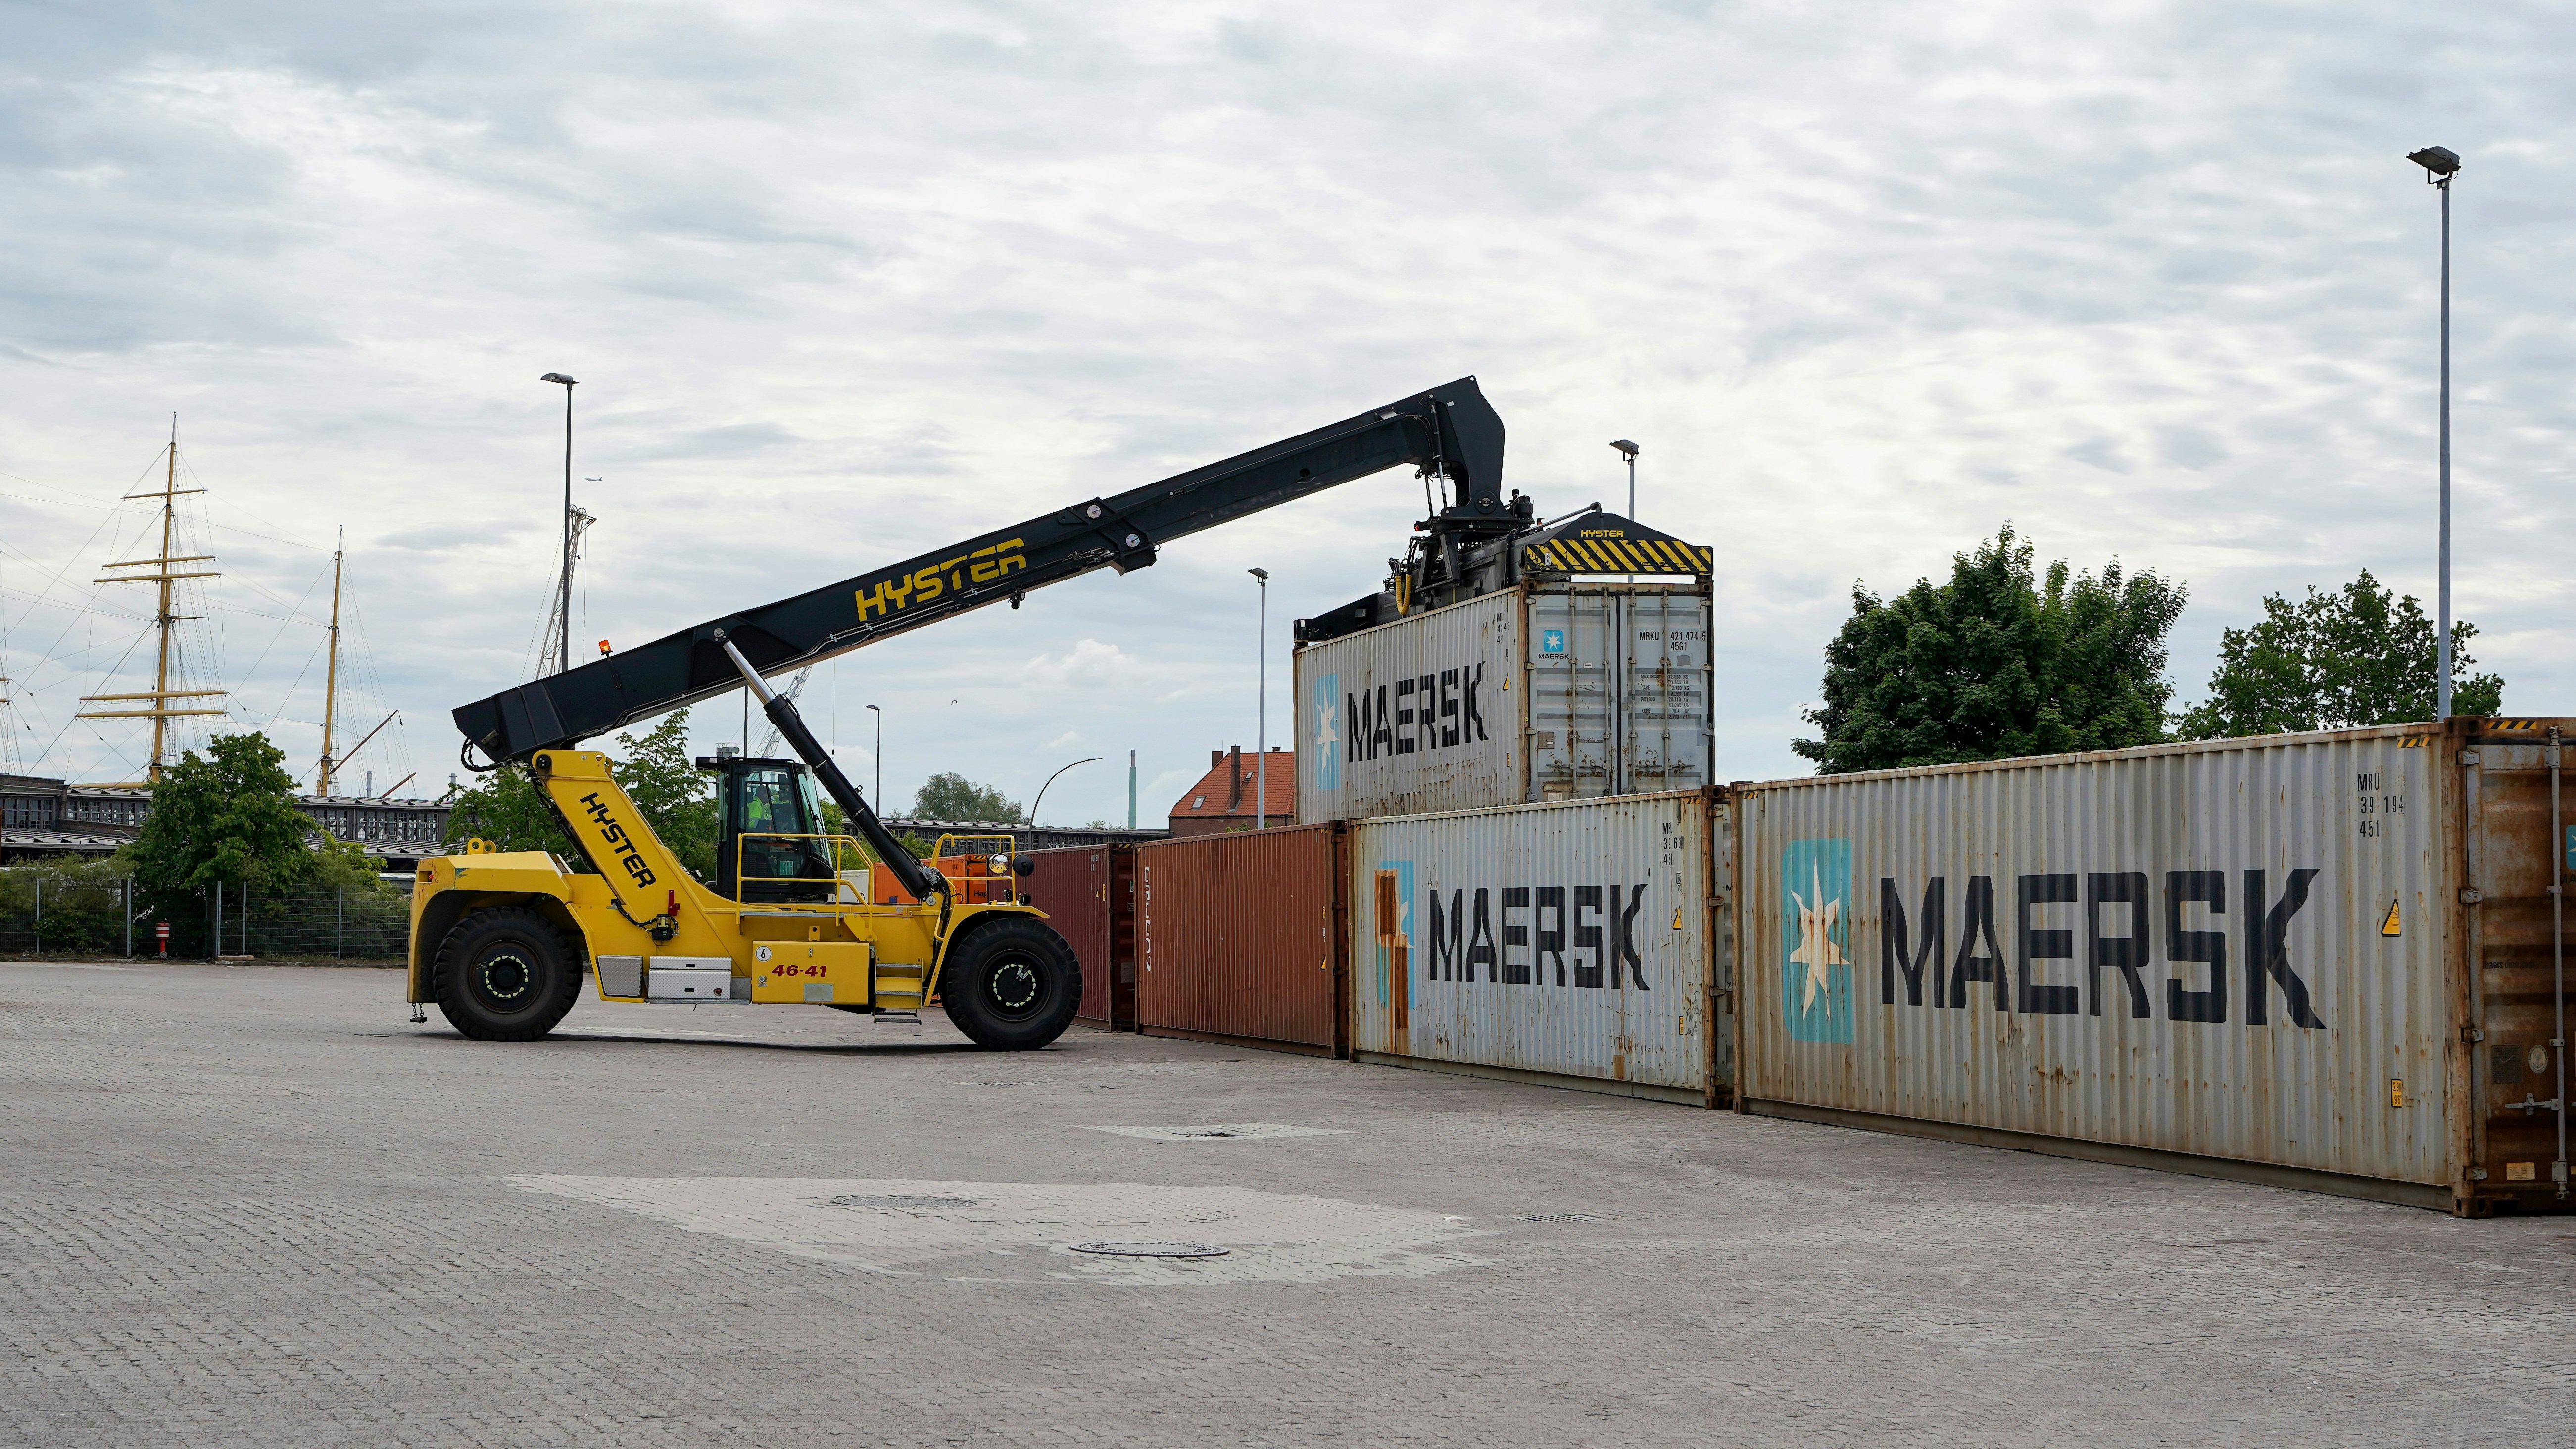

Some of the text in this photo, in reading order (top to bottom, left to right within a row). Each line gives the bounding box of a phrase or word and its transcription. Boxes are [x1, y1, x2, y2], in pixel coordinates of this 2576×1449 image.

[1581, 530, 1624, 538] HYSTER
[855, 538, 1027, 622] HYSTER
[1639, 631, 1659, 641] MRKU
[1670, 632, 1682, 641] 421
[1685, 632, 1698, 641] 474
[1670, 642, 1687, 651] 45G1
[1348, 661, 1489, 763] MAERSK
[579, 792, 656, 889] HYSTER
[761, 948, 766, 958] 6
[1429, 884, 1651, 991] MAERSK
[1881, 868, 2327, 1030] MAERSK
[772, 964, 827, 977] 46-41
